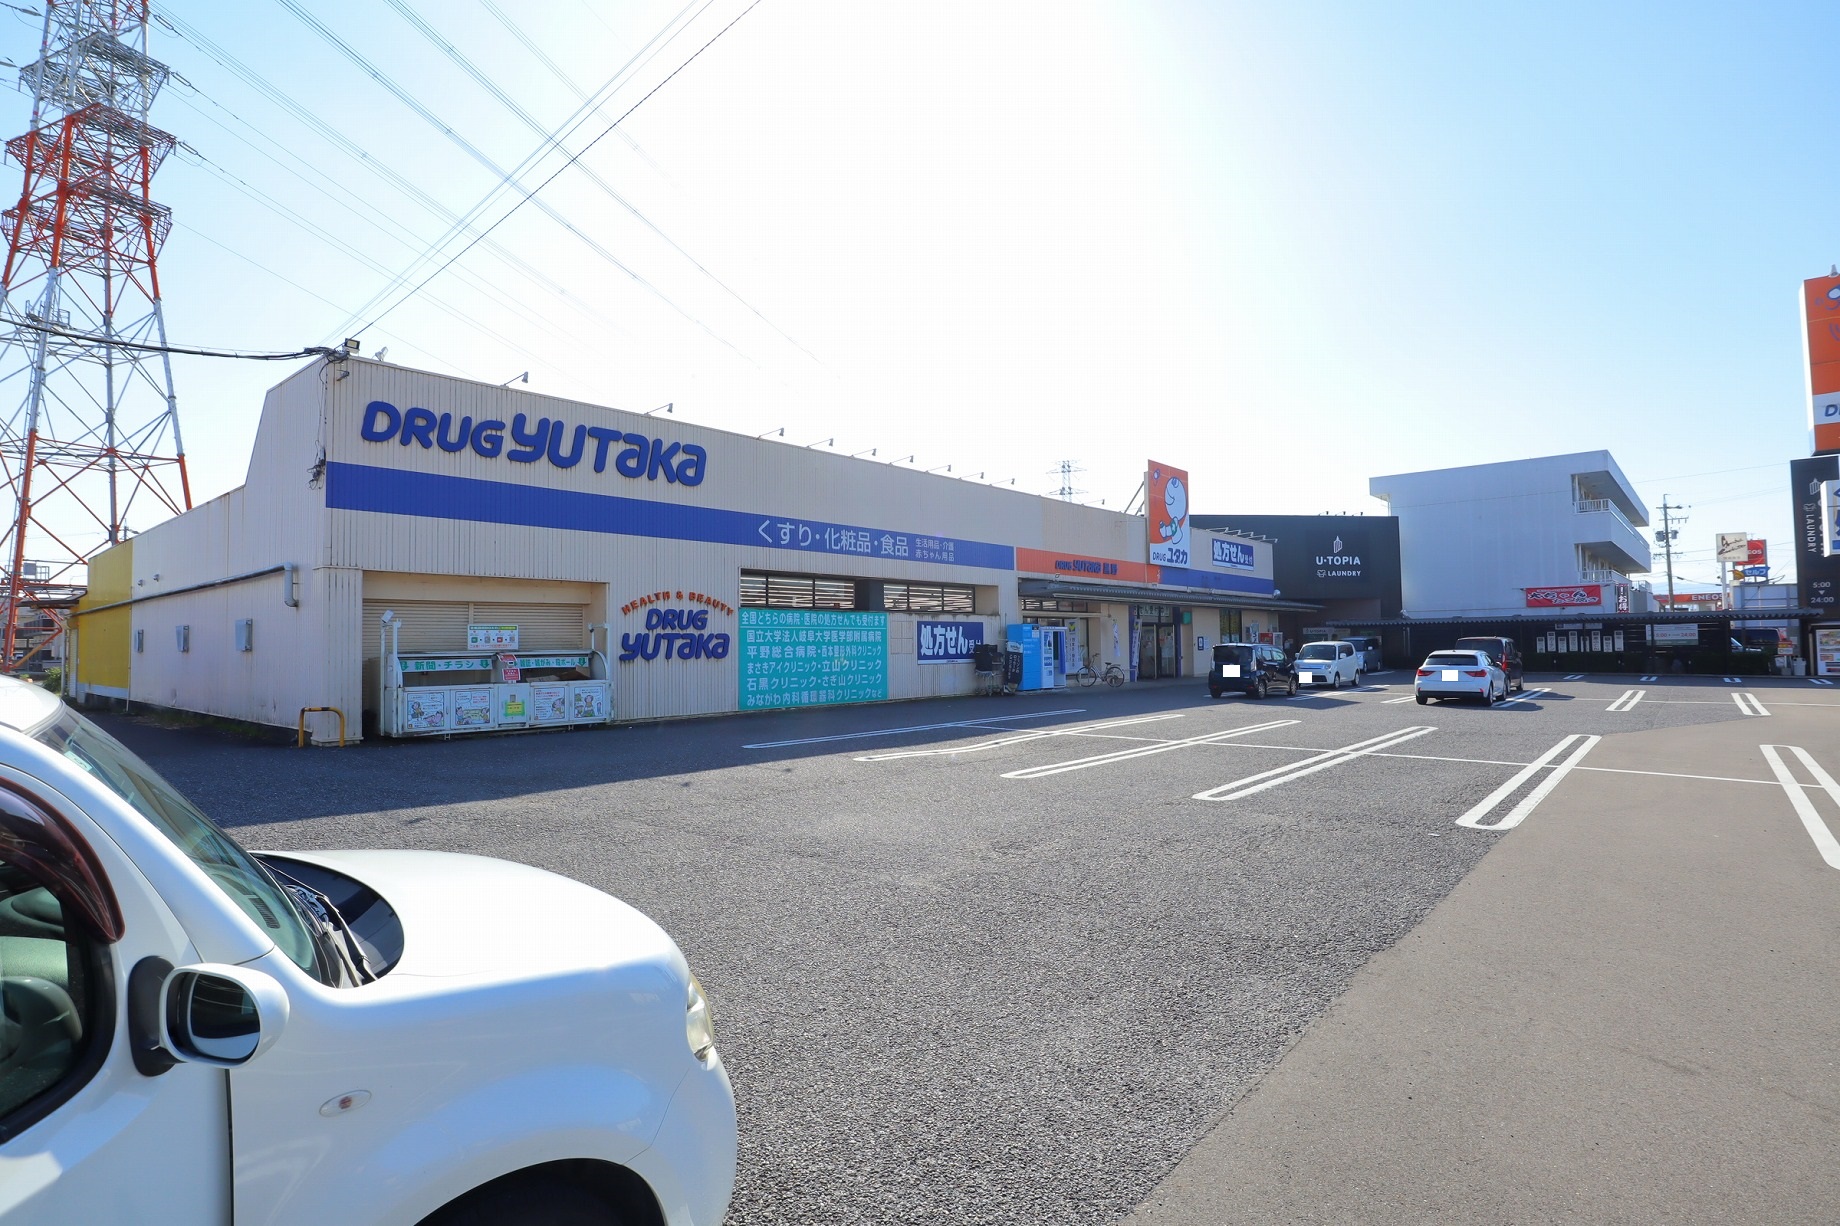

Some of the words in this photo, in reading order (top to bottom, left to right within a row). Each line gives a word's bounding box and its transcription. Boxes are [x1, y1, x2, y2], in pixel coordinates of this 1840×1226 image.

[361, 401, 506, 458] DRUG
[1805, 514, 1817, 553] LAUNDRY
[915, 549, 955, 562] 赤ちゃん用品
[1153, 551, 1167, 562] DRUG
[621, 591, 671, 616] HEALTH
[676, 591, 684, 600] &
[688, 592, 734, 616] BEAUTY
[645, 608, 708, 631] DRUG
